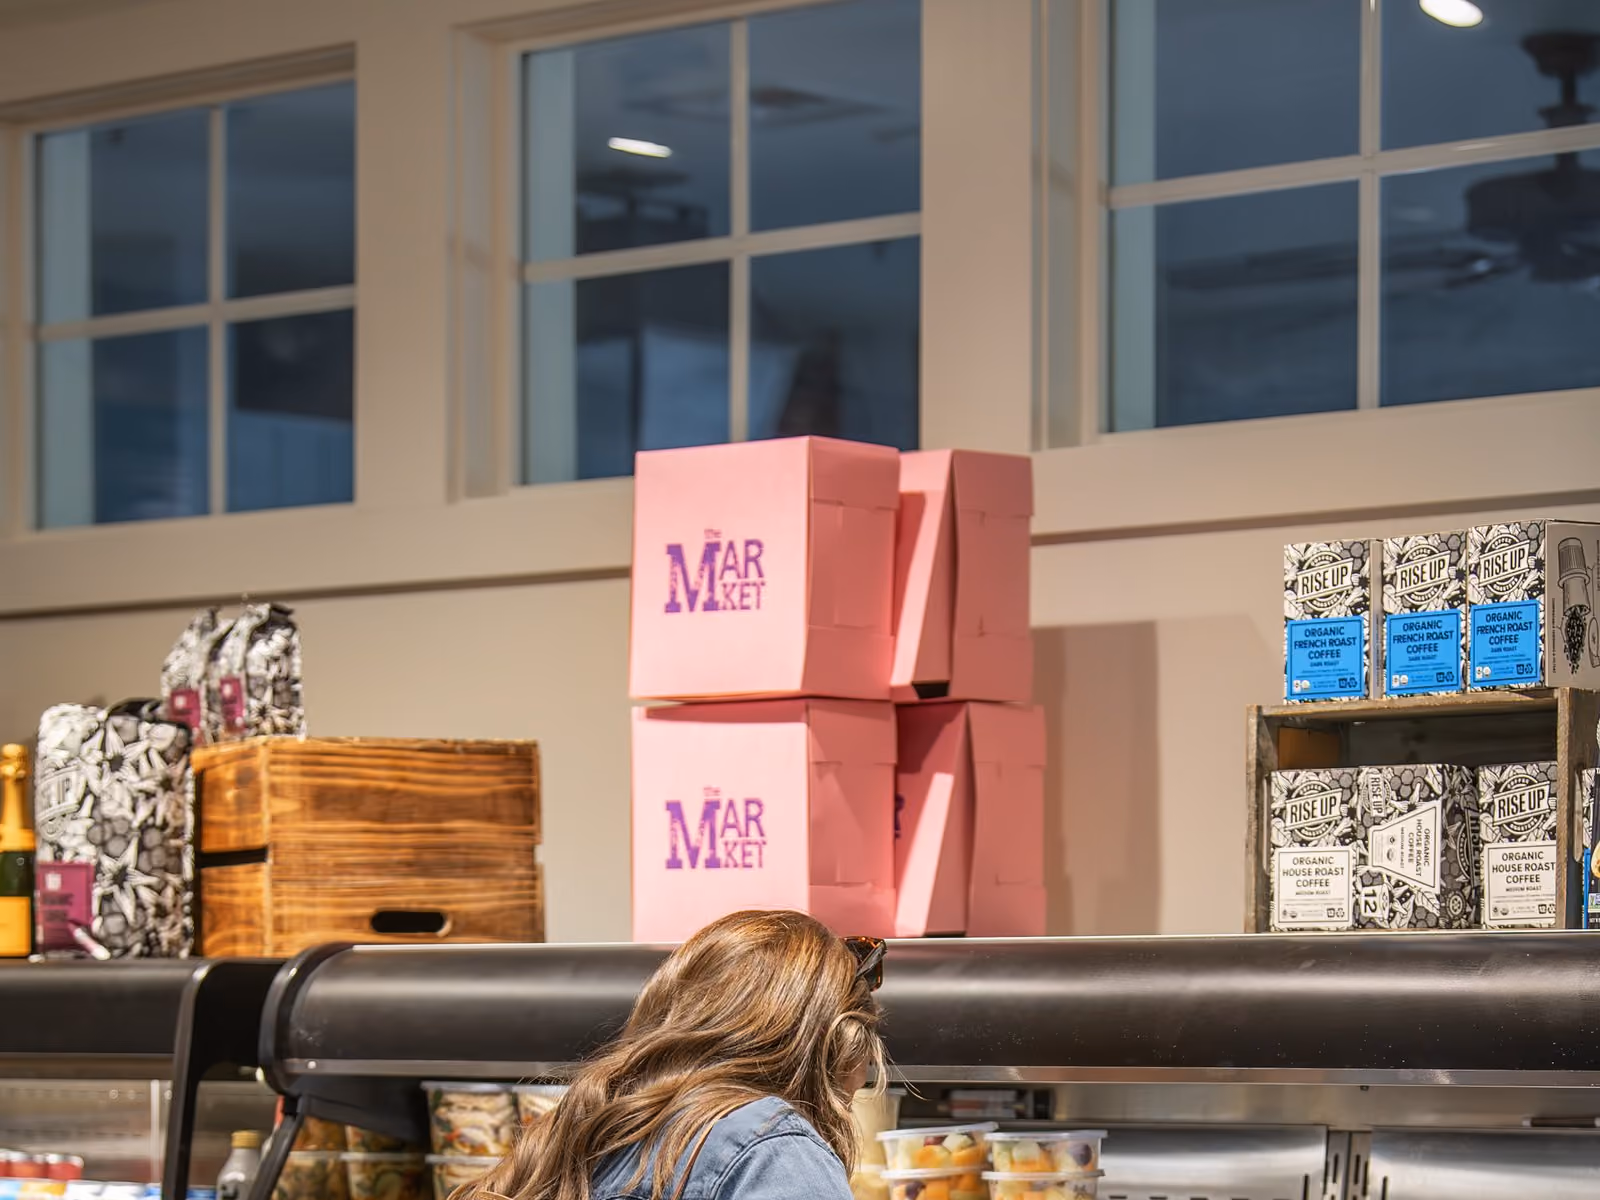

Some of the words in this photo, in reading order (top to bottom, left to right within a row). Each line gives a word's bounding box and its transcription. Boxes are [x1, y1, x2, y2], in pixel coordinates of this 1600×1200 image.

[1483, 553, 1508, 579] RISE
[1510, 548, 1525, 569] UP
[1400, 563, 1427, 589] RISE
[1430, 559, 1445, 580] UP
[1302, 570, 1329, 595] RISE
[1332, 566, 1348, 586] UP
[1486, 611, 1522, 622] ORGANIC
[1403, 620, 1442, 632] ORGANIC
[1477, 624, 1506, 635] FRENCH
[1507, 622, 1533, 632] ROAST
[1304, 627, 1345, 638] ORGANIC
[1393, 633, 1424, 644] FRENCH
[1426, 631, 1454, 641] ROAST
[1294, 639, 1327, 649] FRENCH
[1328, 637, 1357, 647] ROAST
[1489, 634, 1519, 645] COFFEE
[1308, 649, 1341, 660] COFFEE
[1406, 643, 1438, 654] COFFEE
[1370, 777, 1382, 800] RISE
[1290, 800, 1317, 823] RISE
[1320, 796, 1337, 816] UP
[1372, 800, 1383, 814] UP
[1498, 793, 1525, 818] RISE
[1528, 789, 1545, 810] UP
[1423, 828, 1431, 867] ORGANIC
[1292, 856, 1334, 865] ORGANIC
[1502, 851, 1544, 861] ORGANIC
[1415, 849, 1423, 876] ROAST
[1492, 864, 1523, 873] HOUSE
[1525, 862, 1556, 872] ROAST
[1283, 868, 1312, 876] HOUSE
[1315, 868, 1344, 876] ROAST
[1296, 879, 1330, 887] COFFEE
[1506, 874, 1541, 883] COFFEE
[1364, 889, 1377, 914] 12
